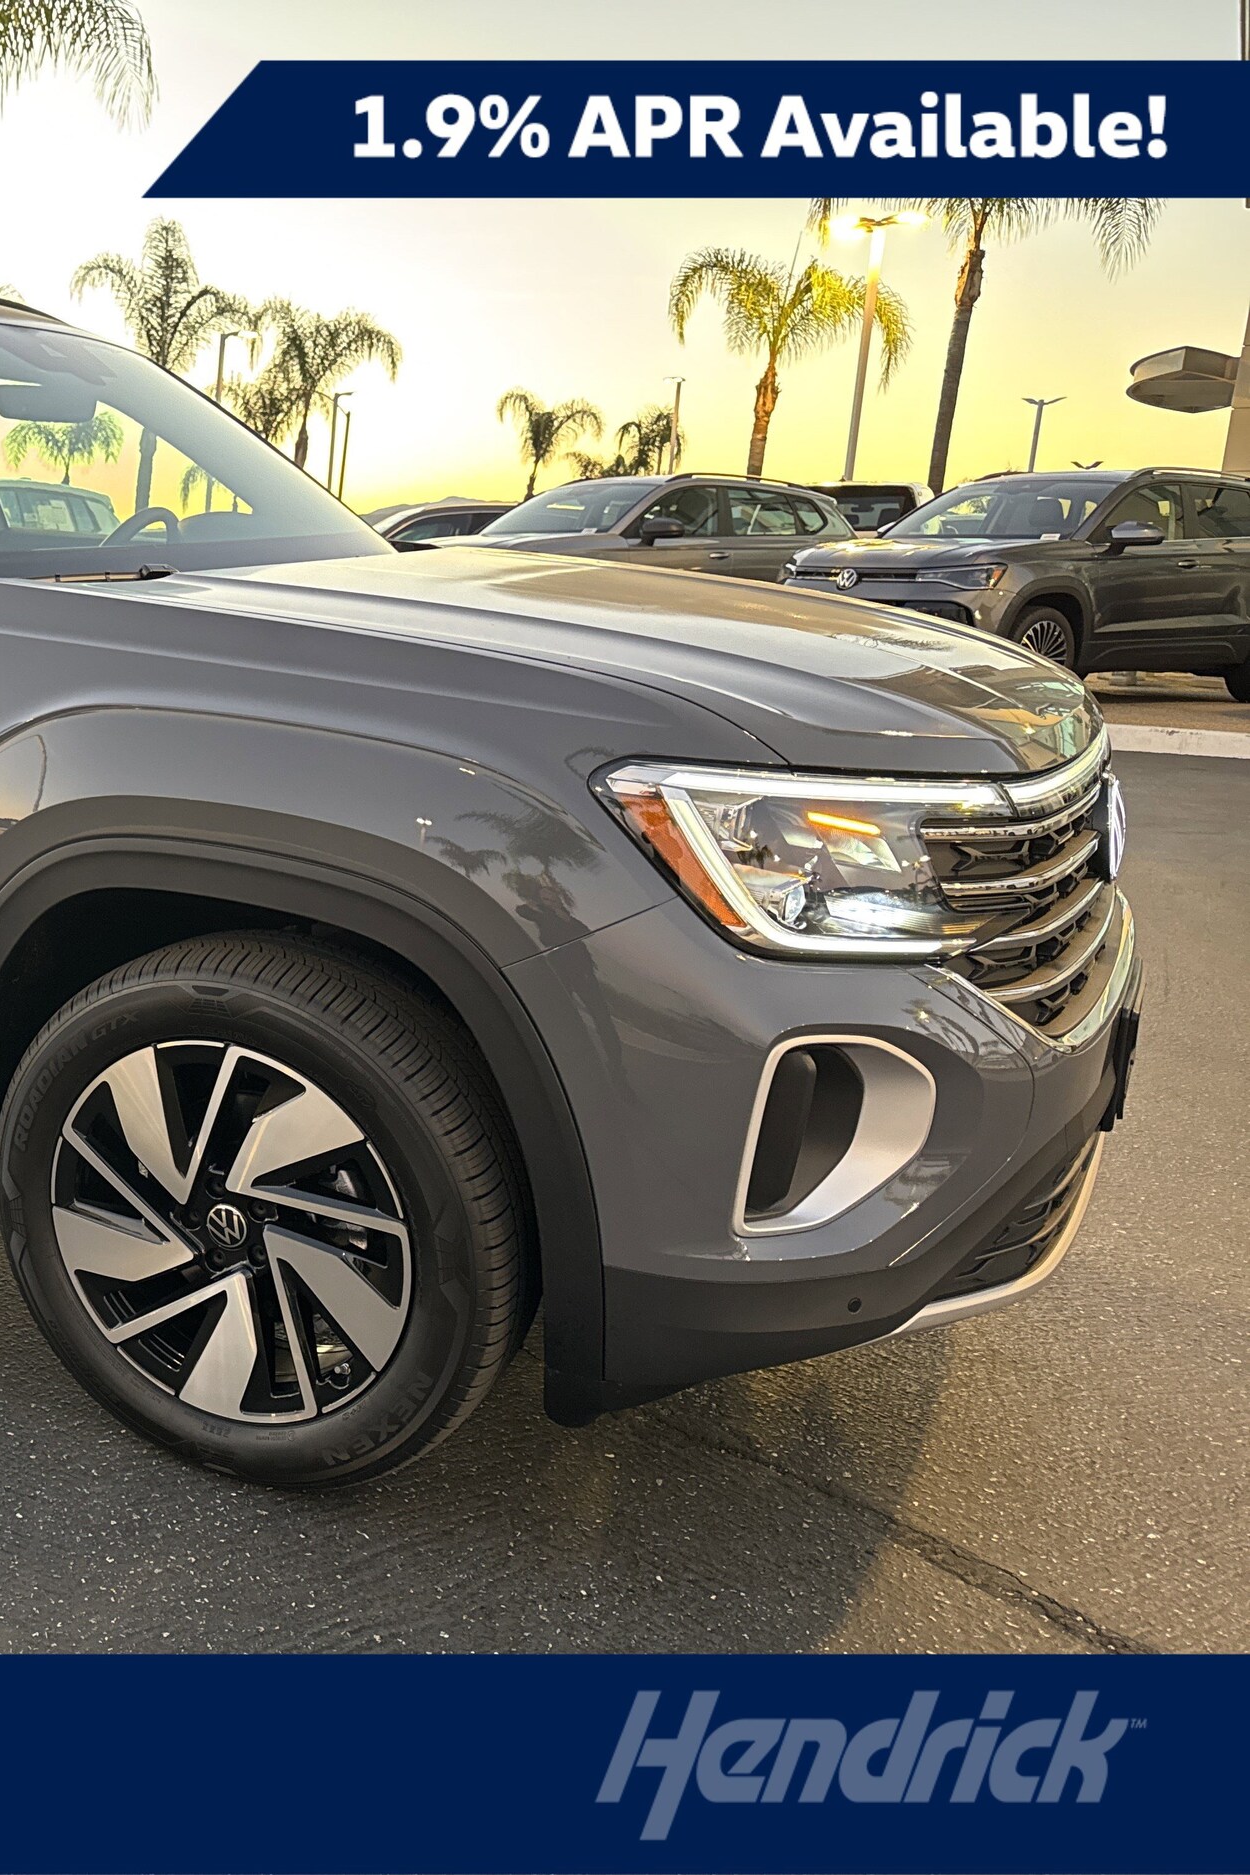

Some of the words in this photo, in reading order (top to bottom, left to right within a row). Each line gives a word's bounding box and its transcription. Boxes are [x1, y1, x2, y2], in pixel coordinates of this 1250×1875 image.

[14, 1029, 88, 1151] ROADIAN
[207, 1204, 247, 1248] VW
[321, 1370, 433, 1466] NEXEN
